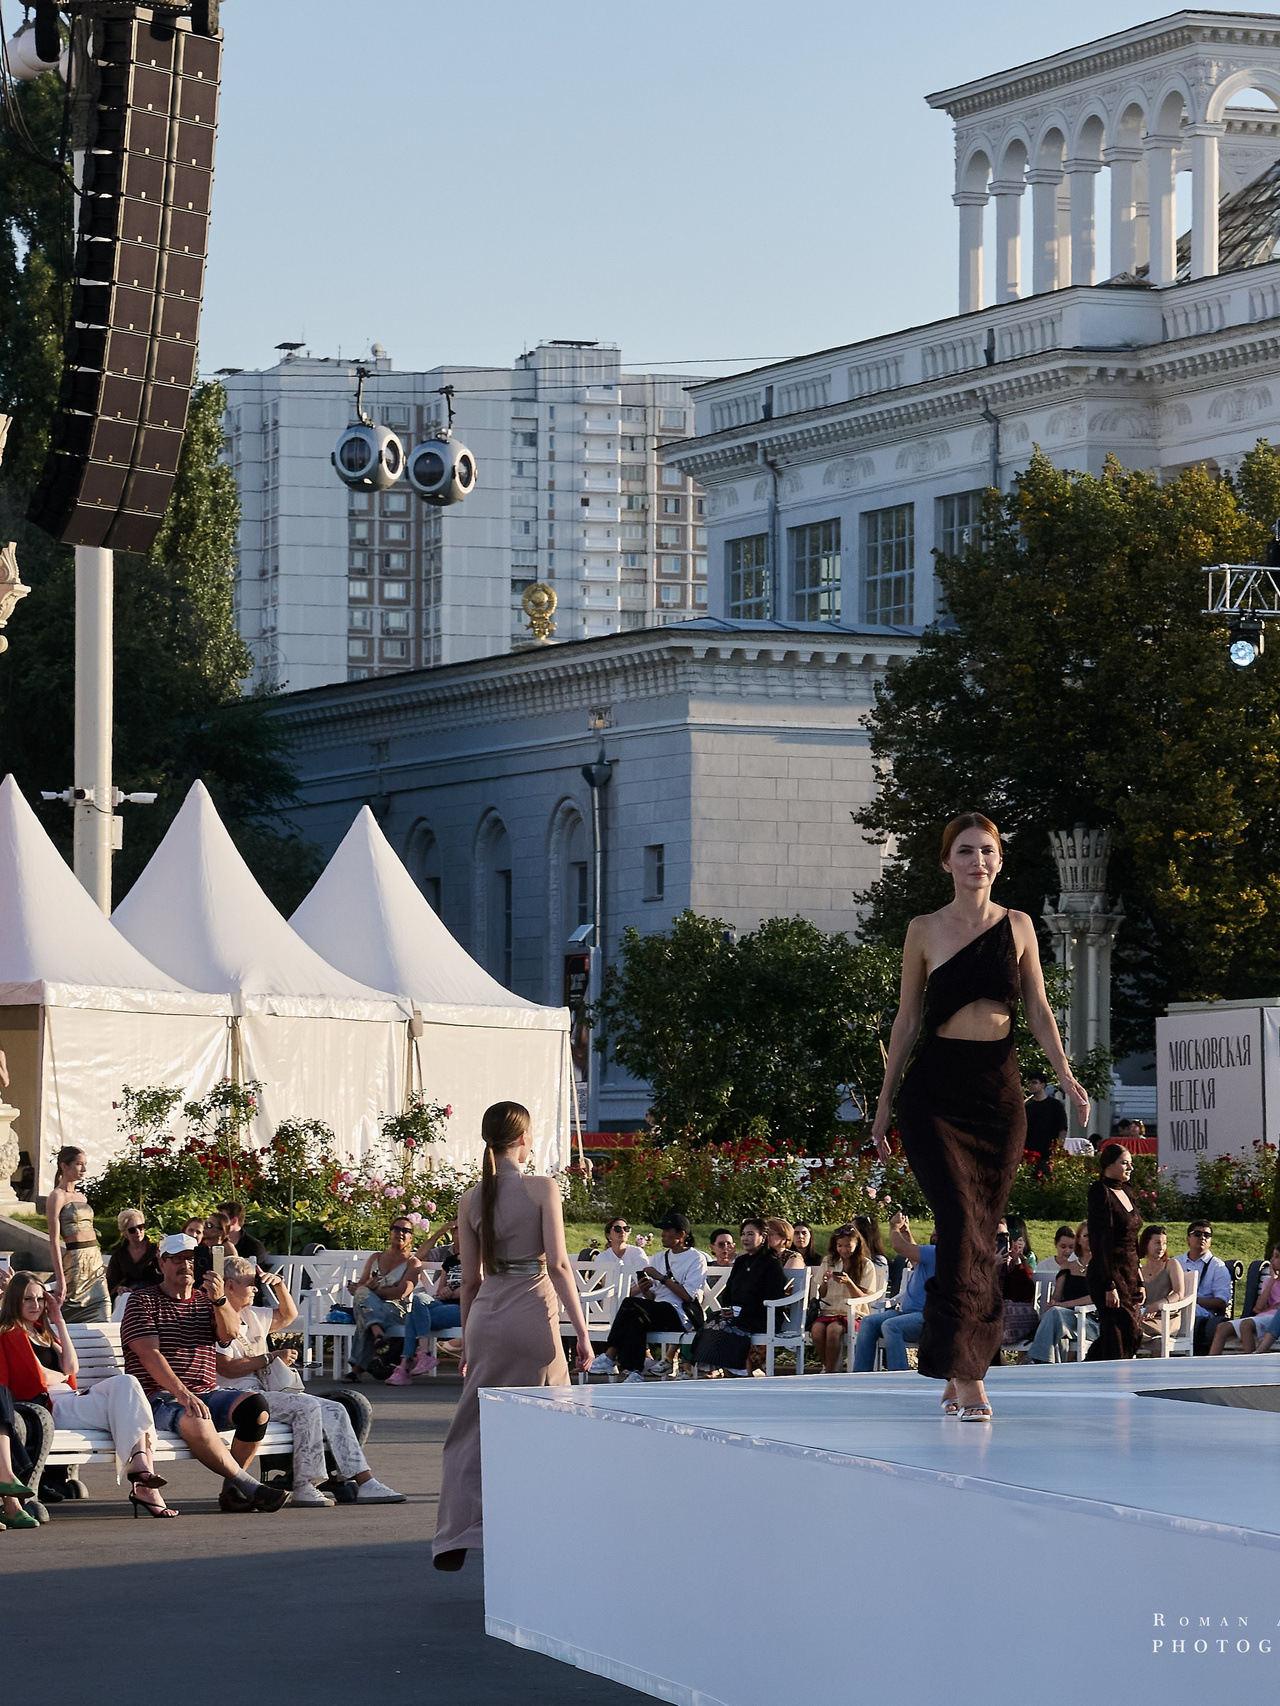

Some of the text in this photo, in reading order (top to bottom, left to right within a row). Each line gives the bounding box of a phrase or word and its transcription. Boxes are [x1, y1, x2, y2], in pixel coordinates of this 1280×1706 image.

[1168, 1033, 1252, 1072] МОСКОВСКАЯ
[1170, 1078, 1215, 1114] НЕДЕЛЯ
[1170, 1118, 1208, 1153] МОДЫ
